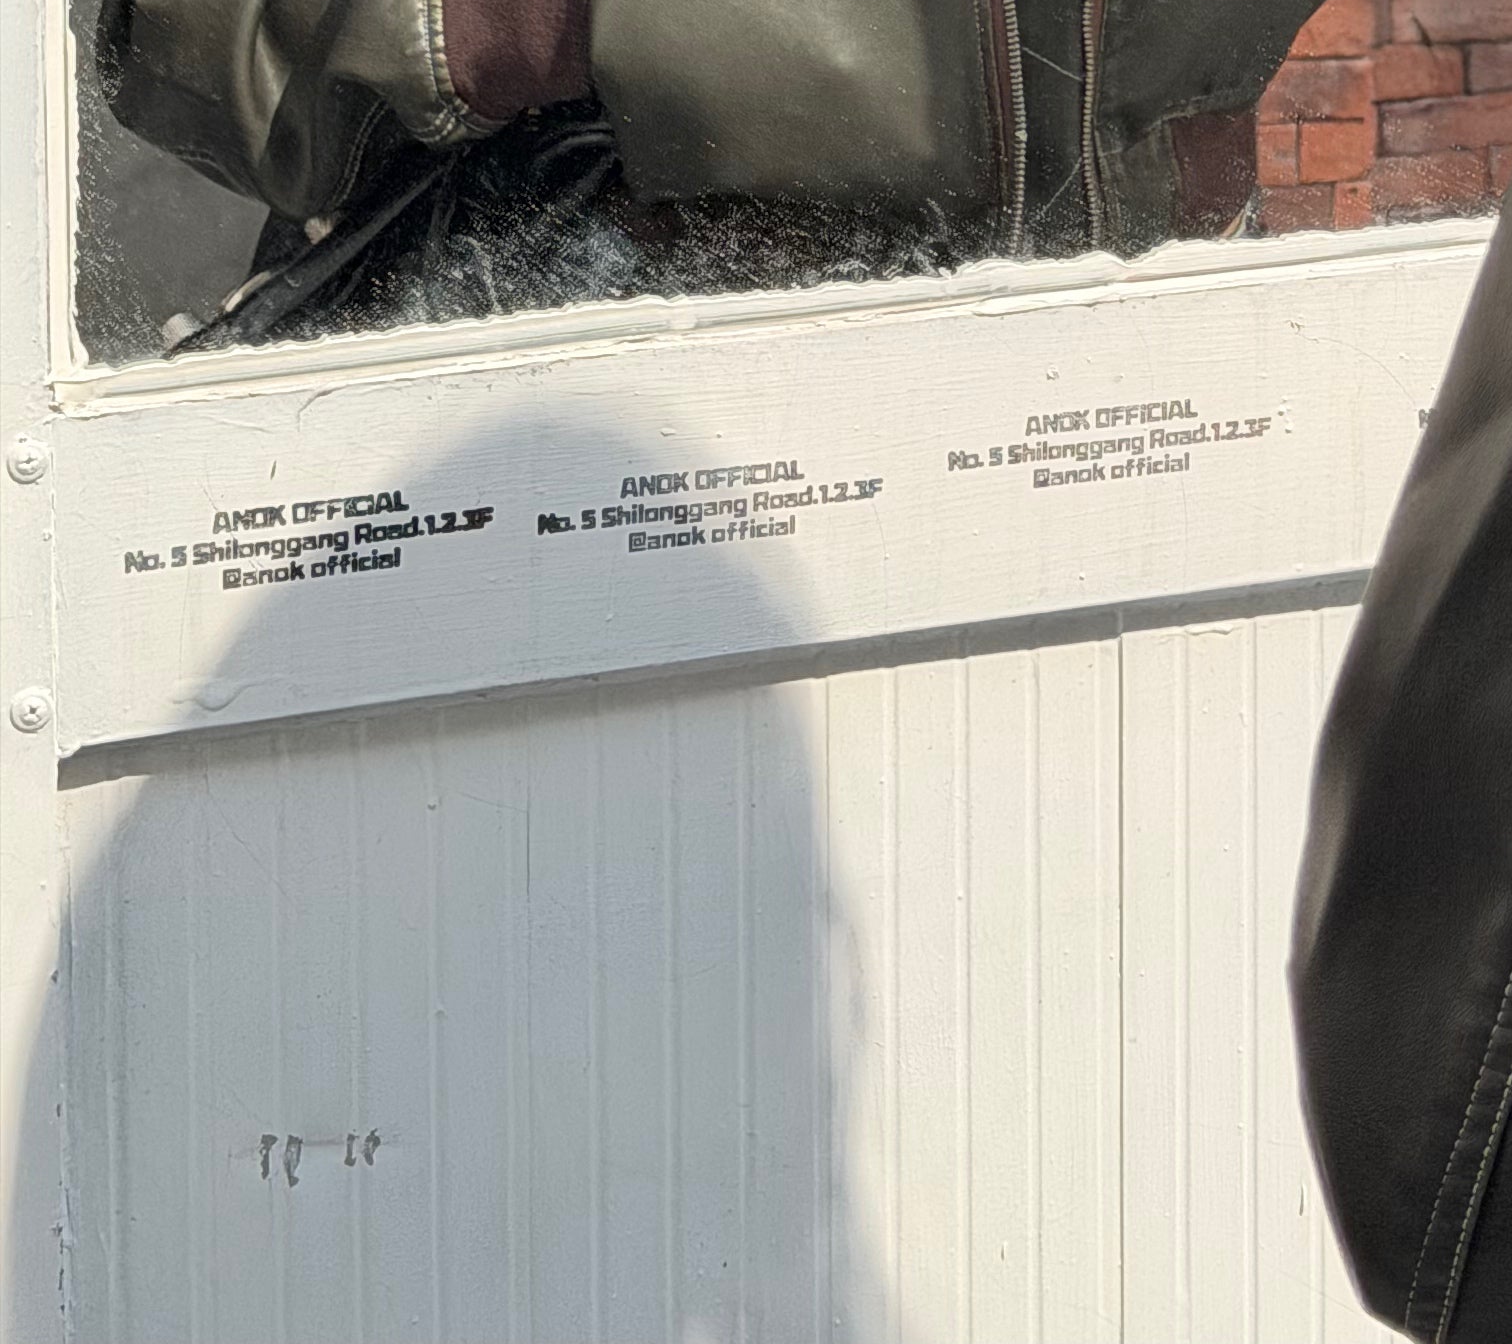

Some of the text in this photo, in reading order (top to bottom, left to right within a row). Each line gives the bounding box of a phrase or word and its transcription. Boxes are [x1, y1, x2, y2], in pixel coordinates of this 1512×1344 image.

[1025, 399, 1198, 436] ANOK OFFICIAL
[948, 451, 984, 472] No.
[988, 446, 1003, 467] 5
[1007, 435, 1145, 465] Shilonggang
[1110, 452, 1190, 480] official
[620, 459, 805, 499] ANOK OFFICIAL
[212, 490, 410, 534] ANOK OFFICIAL
[537, 514, 576, 535] No.
[581, 509, 597, 530] 5
[601, 498, 748, 528] Shilonggang
[124, 550, 167, 574] No.
[171, 545, 187, 568] 5
[192, 531, 349, 566] Shilonggang
[628, 515, 796, 553] @anok official
[310, 547, 401, 577] official
